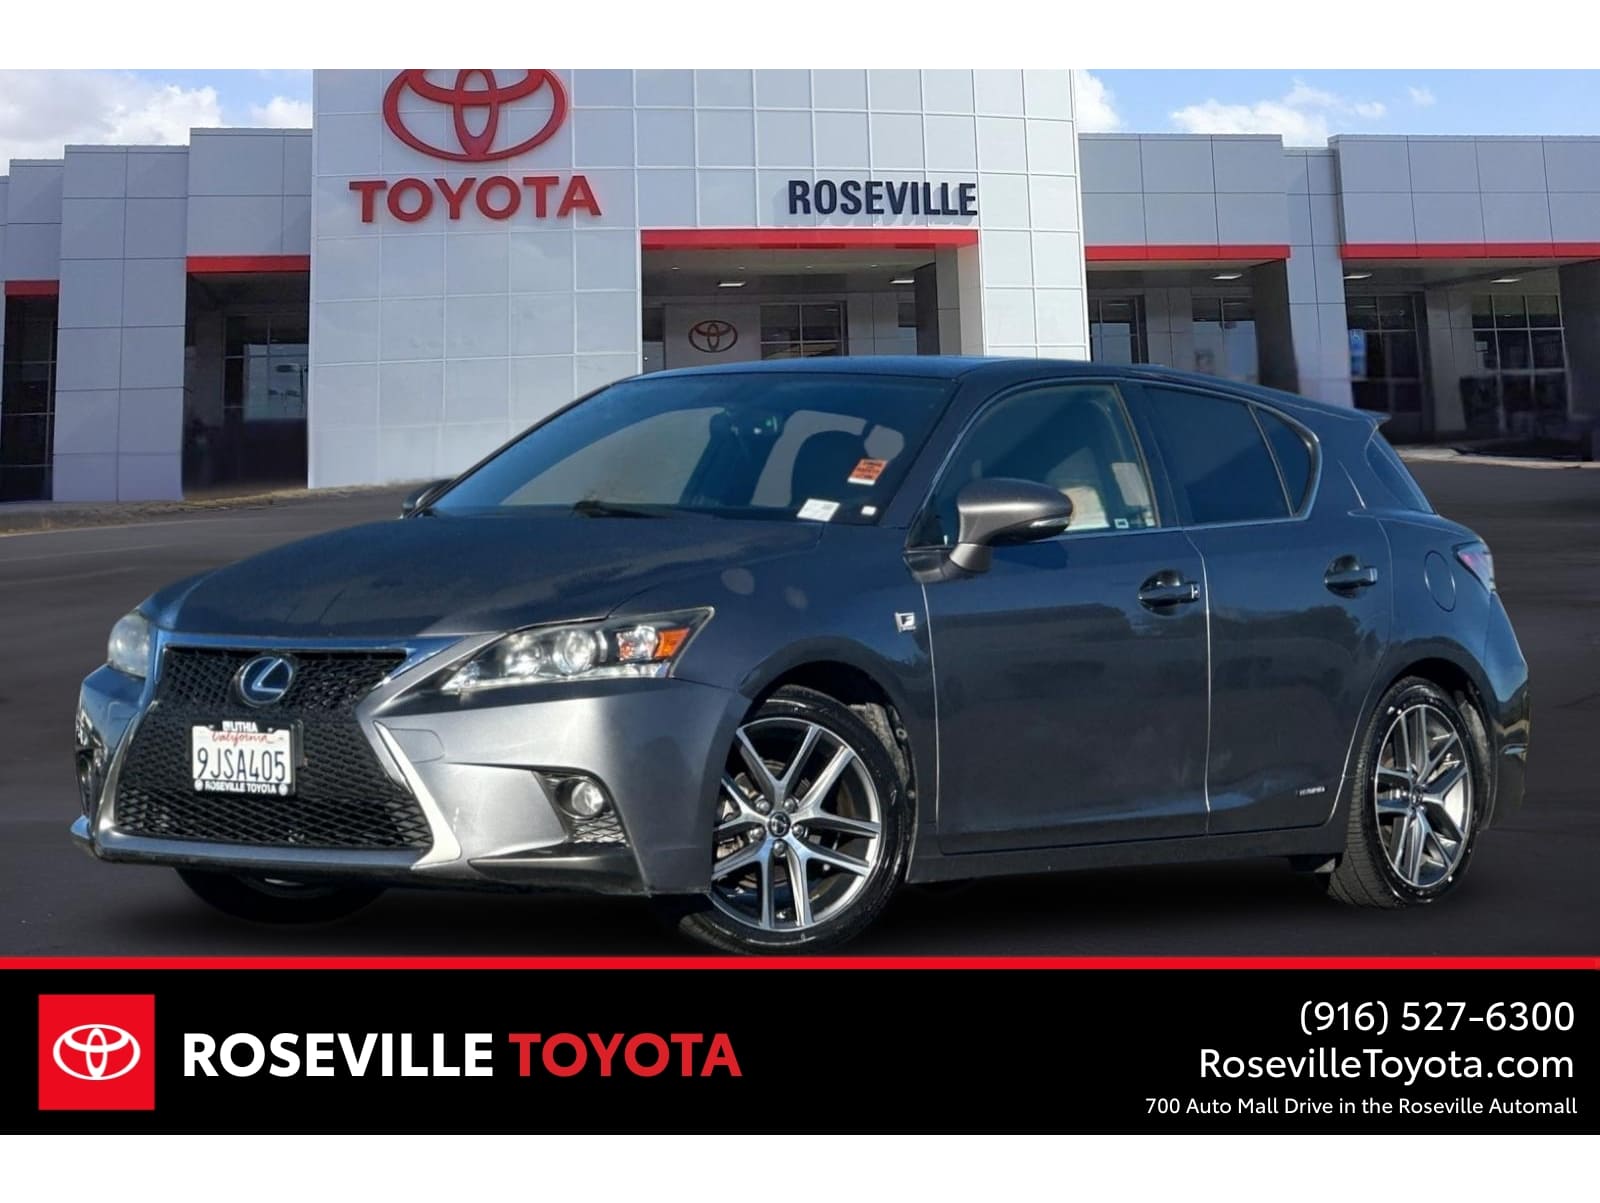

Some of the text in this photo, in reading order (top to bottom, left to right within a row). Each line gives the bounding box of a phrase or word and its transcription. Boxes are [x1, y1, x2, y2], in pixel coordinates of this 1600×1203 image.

[349, 175, 602, 224] TOYOTA
[788, 179, 979, 217] ROSEVILLE
[211, 731, 270, 746] California
[197, 747, 286, 782] 9JSA405
[205, 780, 277, 794] ROSEVILLE TOYOTA
